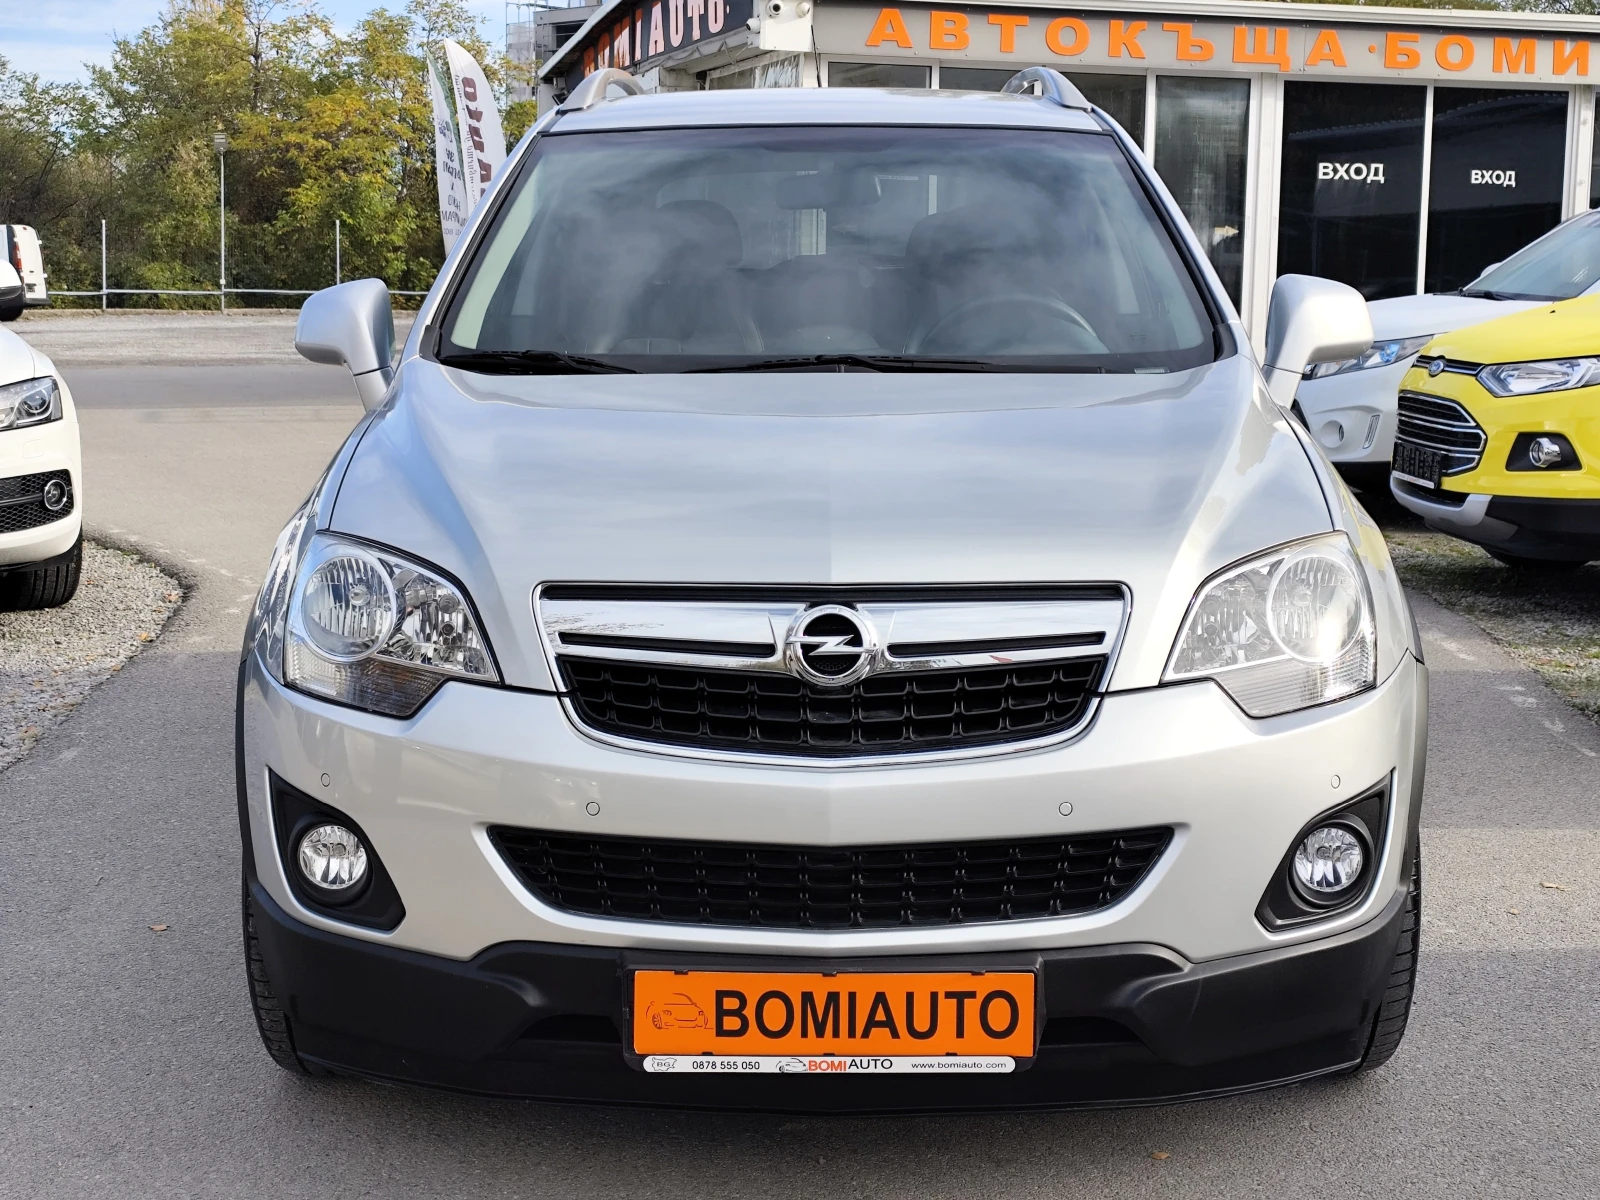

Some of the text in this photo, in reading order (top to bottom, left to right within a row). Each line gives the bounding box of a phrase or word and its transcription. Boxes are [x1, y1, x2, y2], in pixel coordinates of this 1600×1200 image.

[865, 8, 1591, 76] АВТОКЪЩА БОМИ
[1317, 162, 1385, 184] ВХОД
[1470, 169, 1516, 188] ВХОД
[714, 989, 1020, 1040] BOMIAUTO
[692, 1060, 717, 1070] 0878
[720, 1061, 739, 1070] 555
[741, 1061, 760, 1070] 050
[911, 1061, 1007, 1069] www.bomiauto.com
